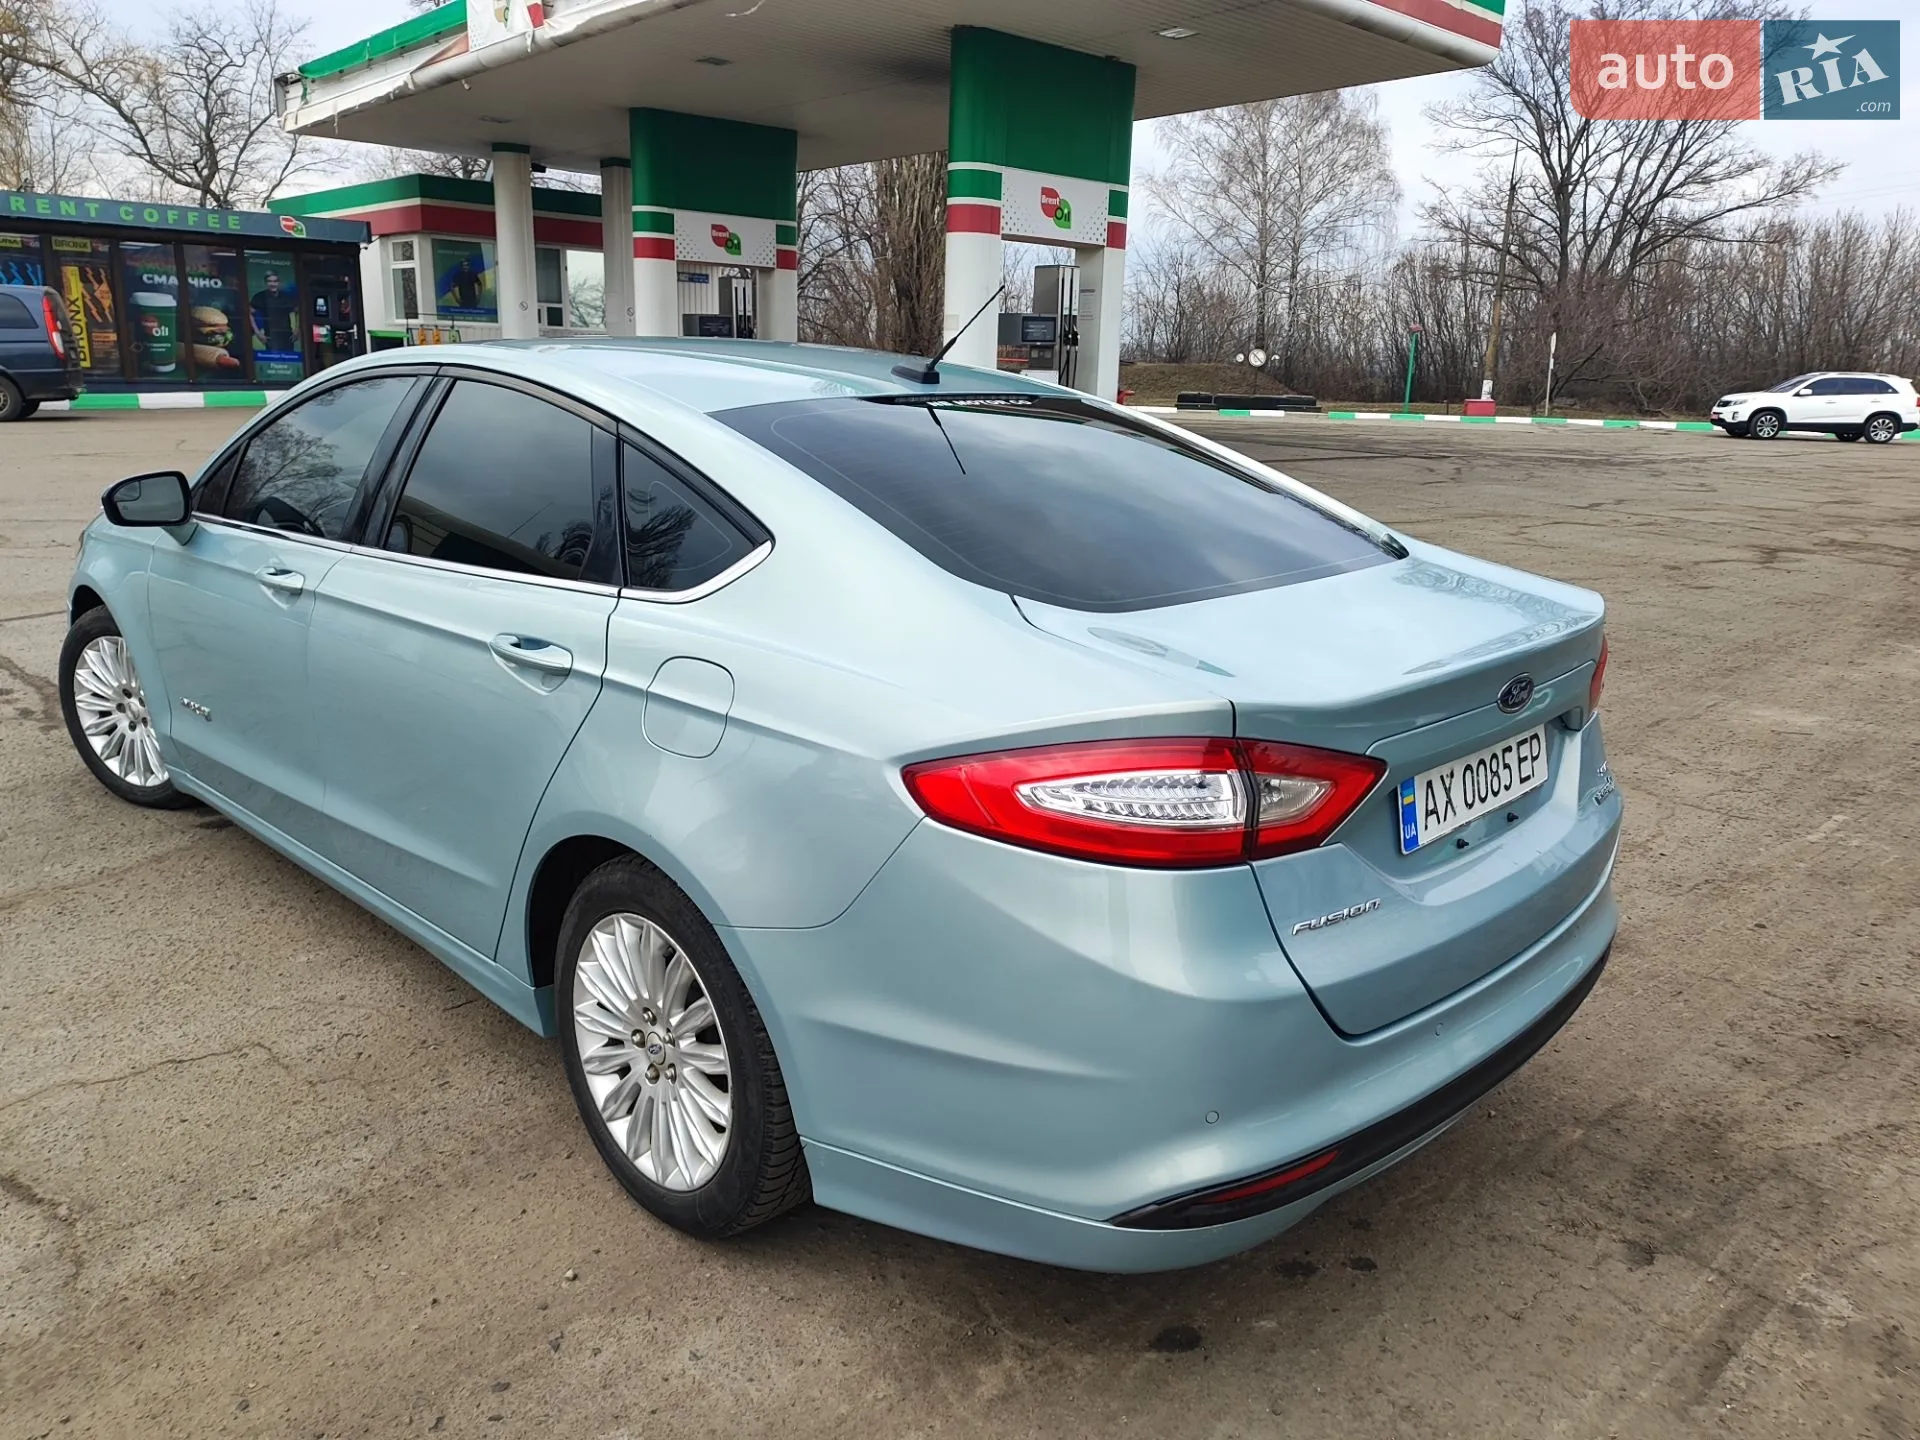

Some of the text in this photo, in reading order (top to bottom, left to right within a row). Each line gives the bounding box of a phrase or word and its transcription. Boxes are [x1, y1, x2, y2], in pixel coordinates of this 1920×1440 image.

[1041, 194, 1060, 206] Brent
[119, 206, 241, 230] COFFEE
[1054, 207, 1071, 222] Oil
[1424, 732, 1541, 832] AX 0085 EP
[1404, 822, 1417, 840] UA
